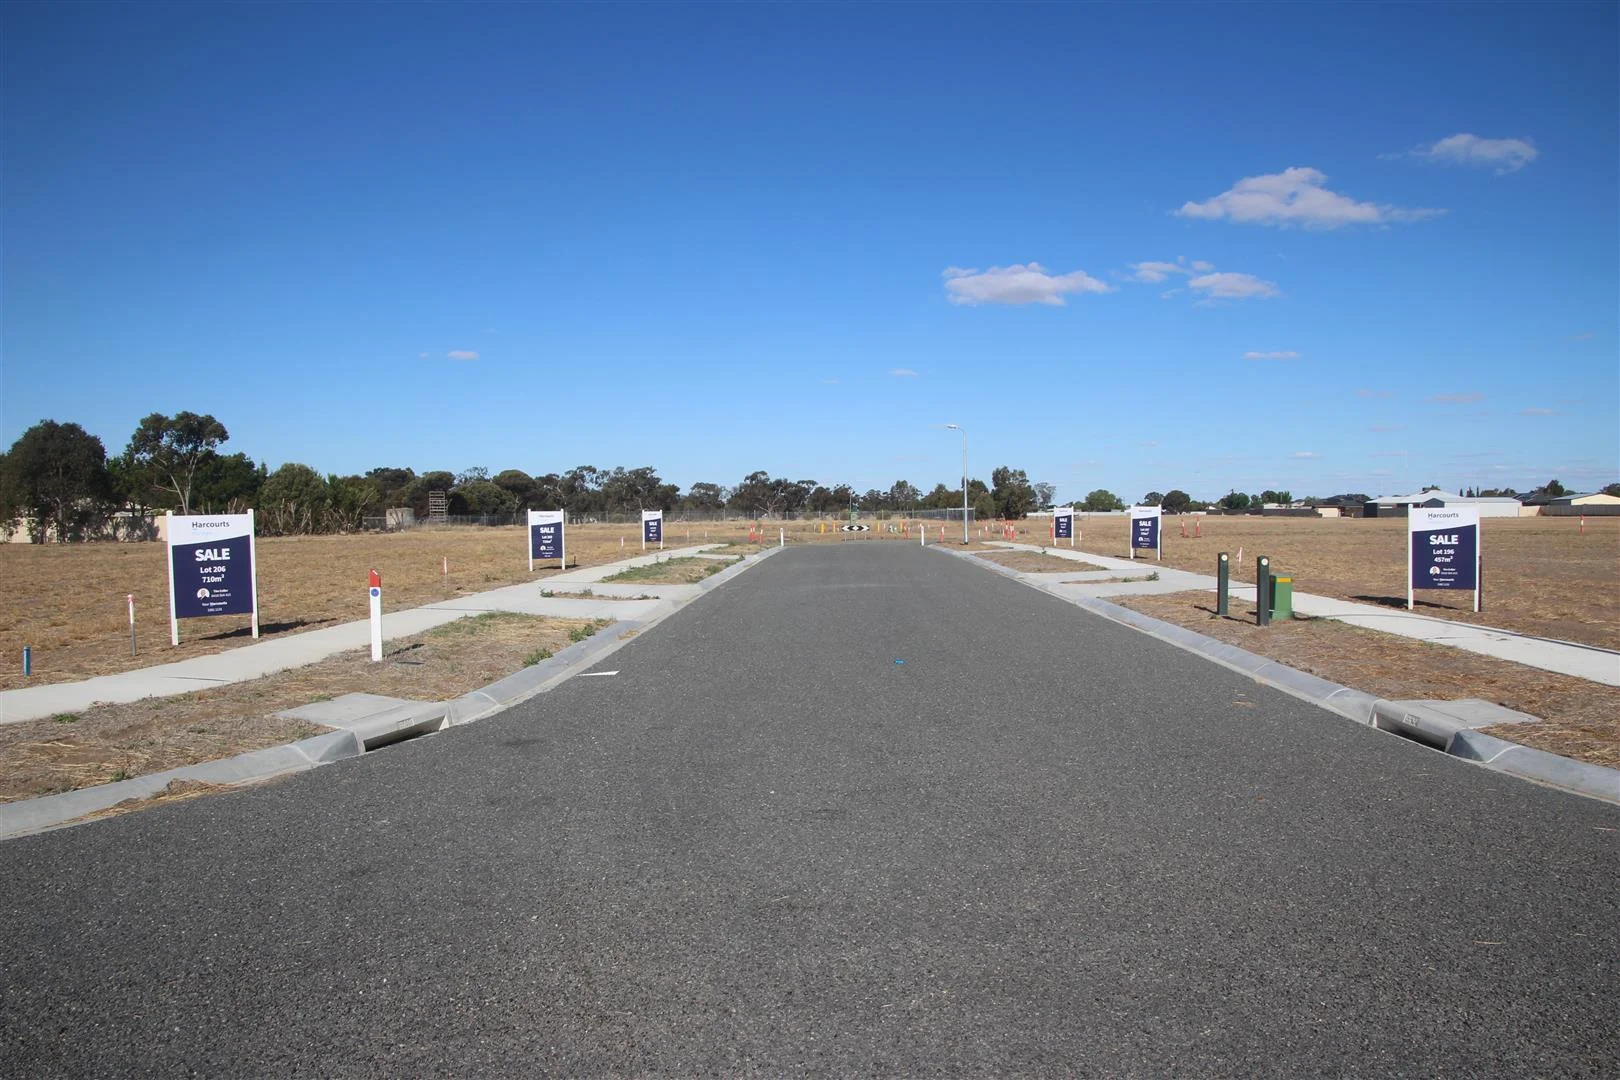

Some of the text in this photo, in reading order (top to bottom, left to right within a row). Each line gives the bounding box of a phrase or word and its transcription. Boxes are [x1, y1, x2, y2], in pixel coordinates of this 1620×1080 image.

[191, 521, 230, 529] Harcourts
[1429, 534, 1459, 545] SALE
[194, 547, 231, 562] SALE
[200, 565, 226, 574] Lot 206
